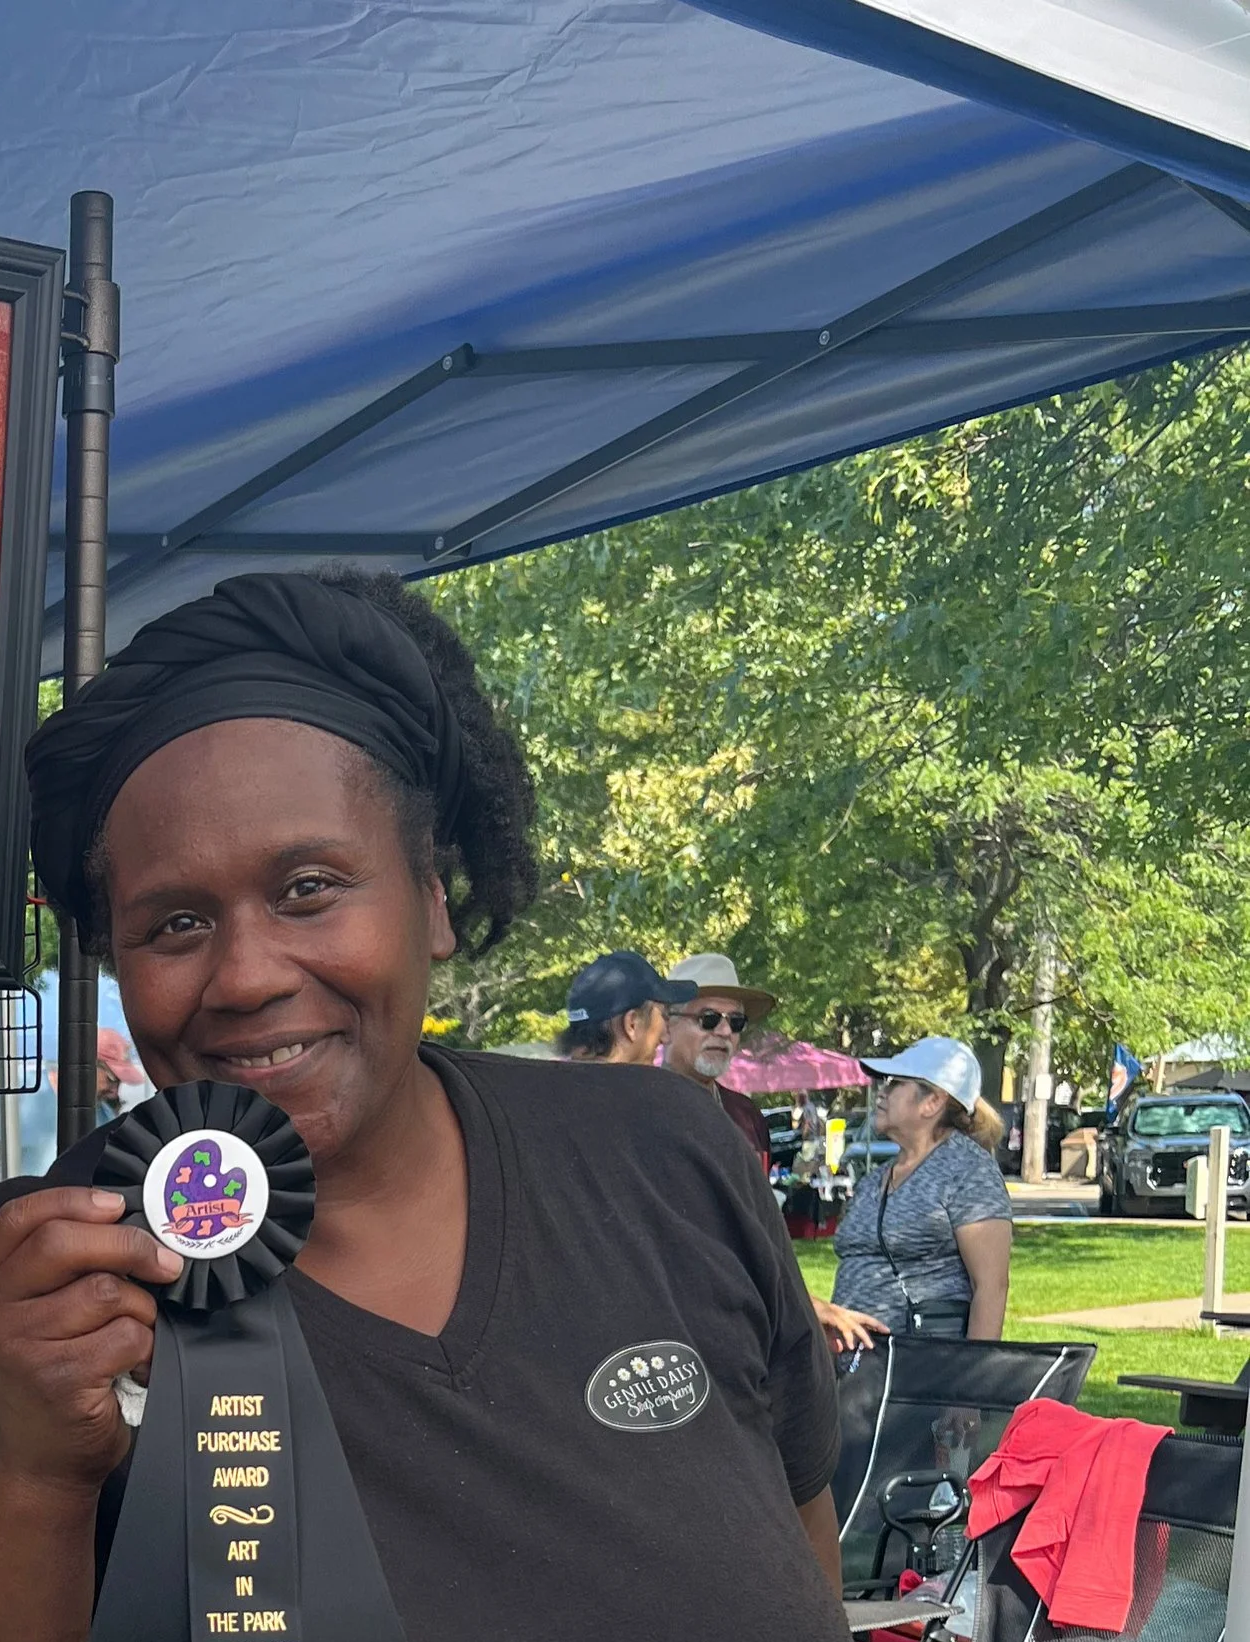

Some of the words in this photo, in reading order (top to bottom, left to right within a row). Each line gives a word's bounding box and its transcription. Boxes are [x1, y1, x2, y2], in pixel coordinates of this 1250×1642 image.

[185, 1201, 226, 1217] Artist
[603, 1379, 658, 1410] GENTLE
[656, 1361, 699, 1390] DAISY
[210, 1395, 265, 1417] ARTIST
[197, 1430, 282, 1453] PURCHASE
[212, 1466, 270, 1488] AWARD
[227, 1540, 260, 1562] ART
[235, 1576, 254, 1597] IN
[206, 1611, 240, 1633] THE
[243, 1610, 288, 1632] PARK
